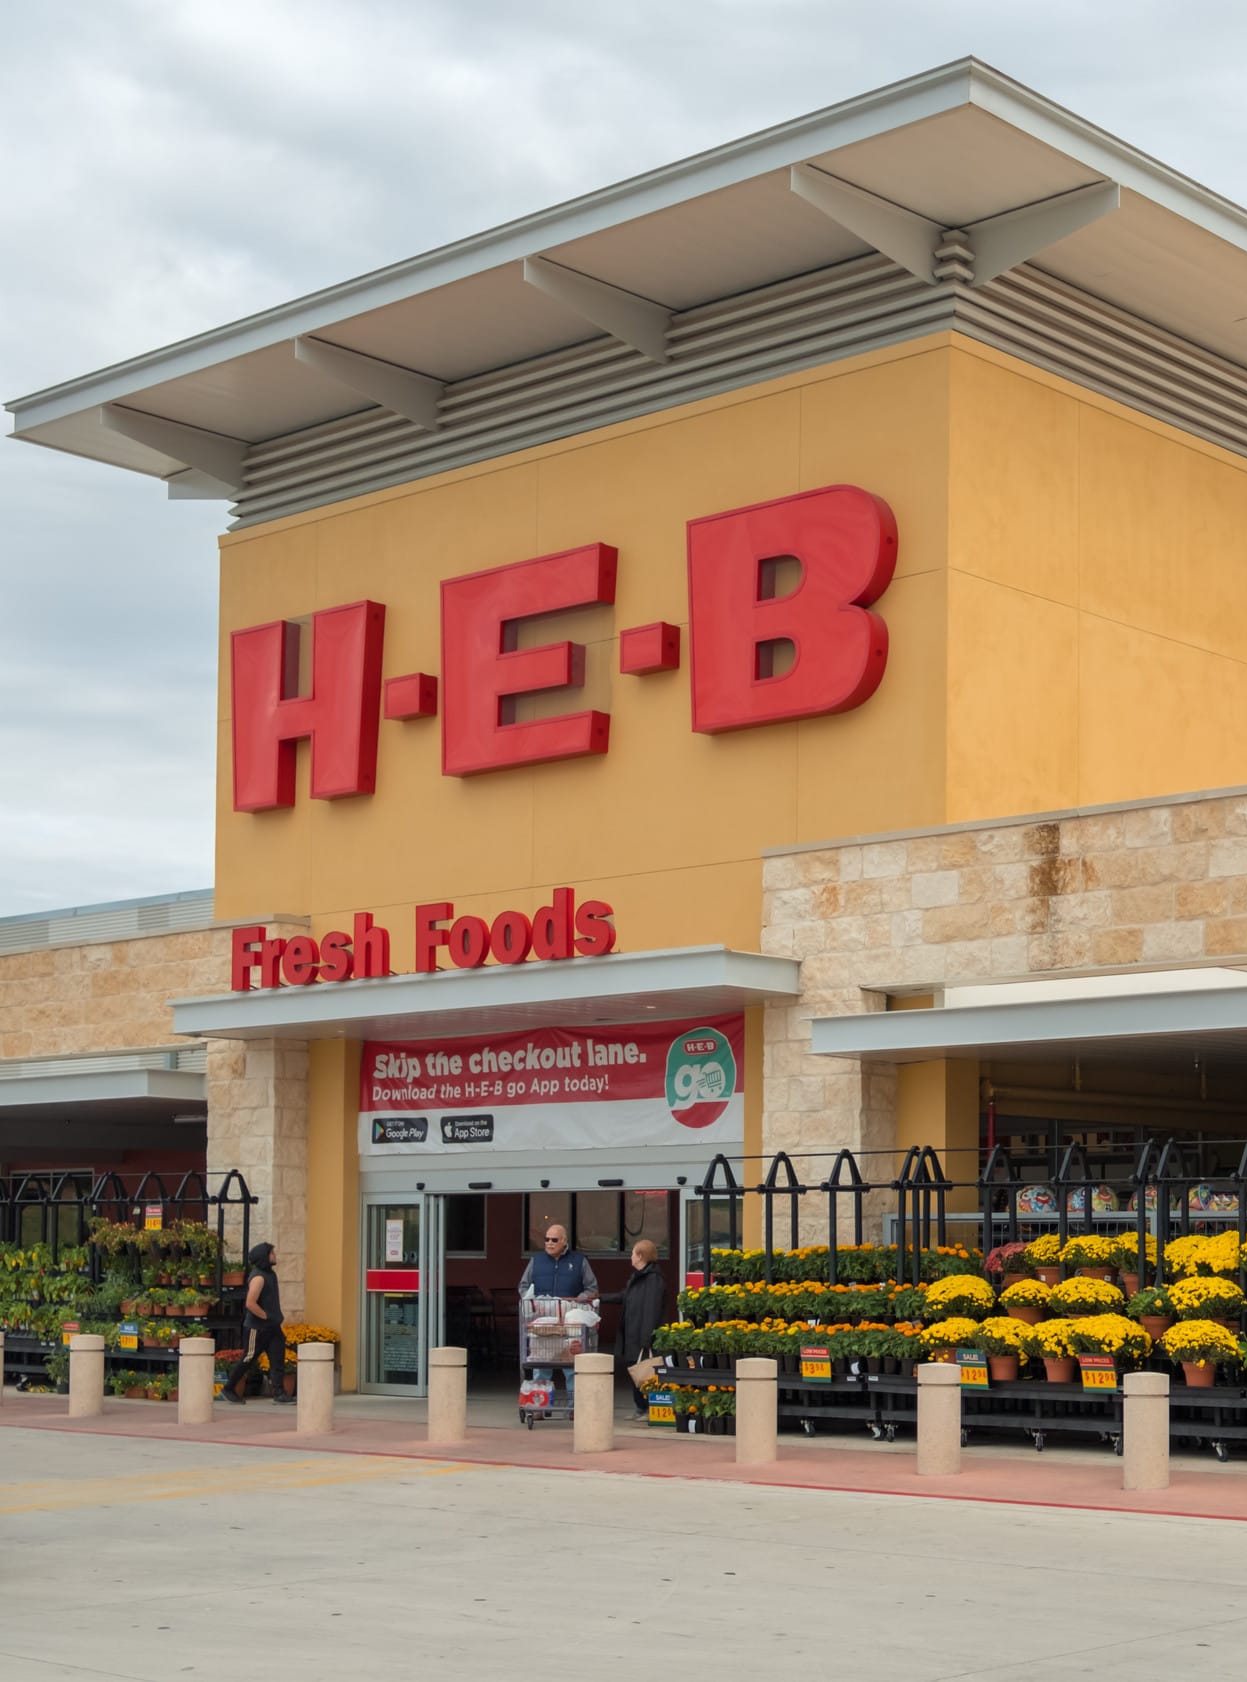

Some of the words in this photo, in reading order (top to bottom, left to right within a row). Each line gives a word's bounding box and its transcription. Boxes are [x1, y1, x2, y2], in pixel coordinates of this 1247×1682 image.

[230, 484, 899, 814] H-E-B
[231, 912, 391, 992] Fresh
[415, 887, 616, 973] Foods
[373, 1053, 421, 1083] Skip
[425, 1052, 463, 1077] the
[469, 1041, 582, 1074] checkout
[586, 1039, 647, 1067] lane.
[372, 1083, 437, 1102] Download
[440, 1083, 461, 1100] the
[465, 1080, 503, 1098] H-E-B
[507, 1081, 526, 1098] go
[530, 1077, 560, 1096] App
[564, 1073, 609, 1094] today!
[385, 1127, 408, 1140] Google
[409, 1127, 425, 1140] Play
[454, 1127, 469, 1139] App
[469, 1127, 490, 1138] Store
